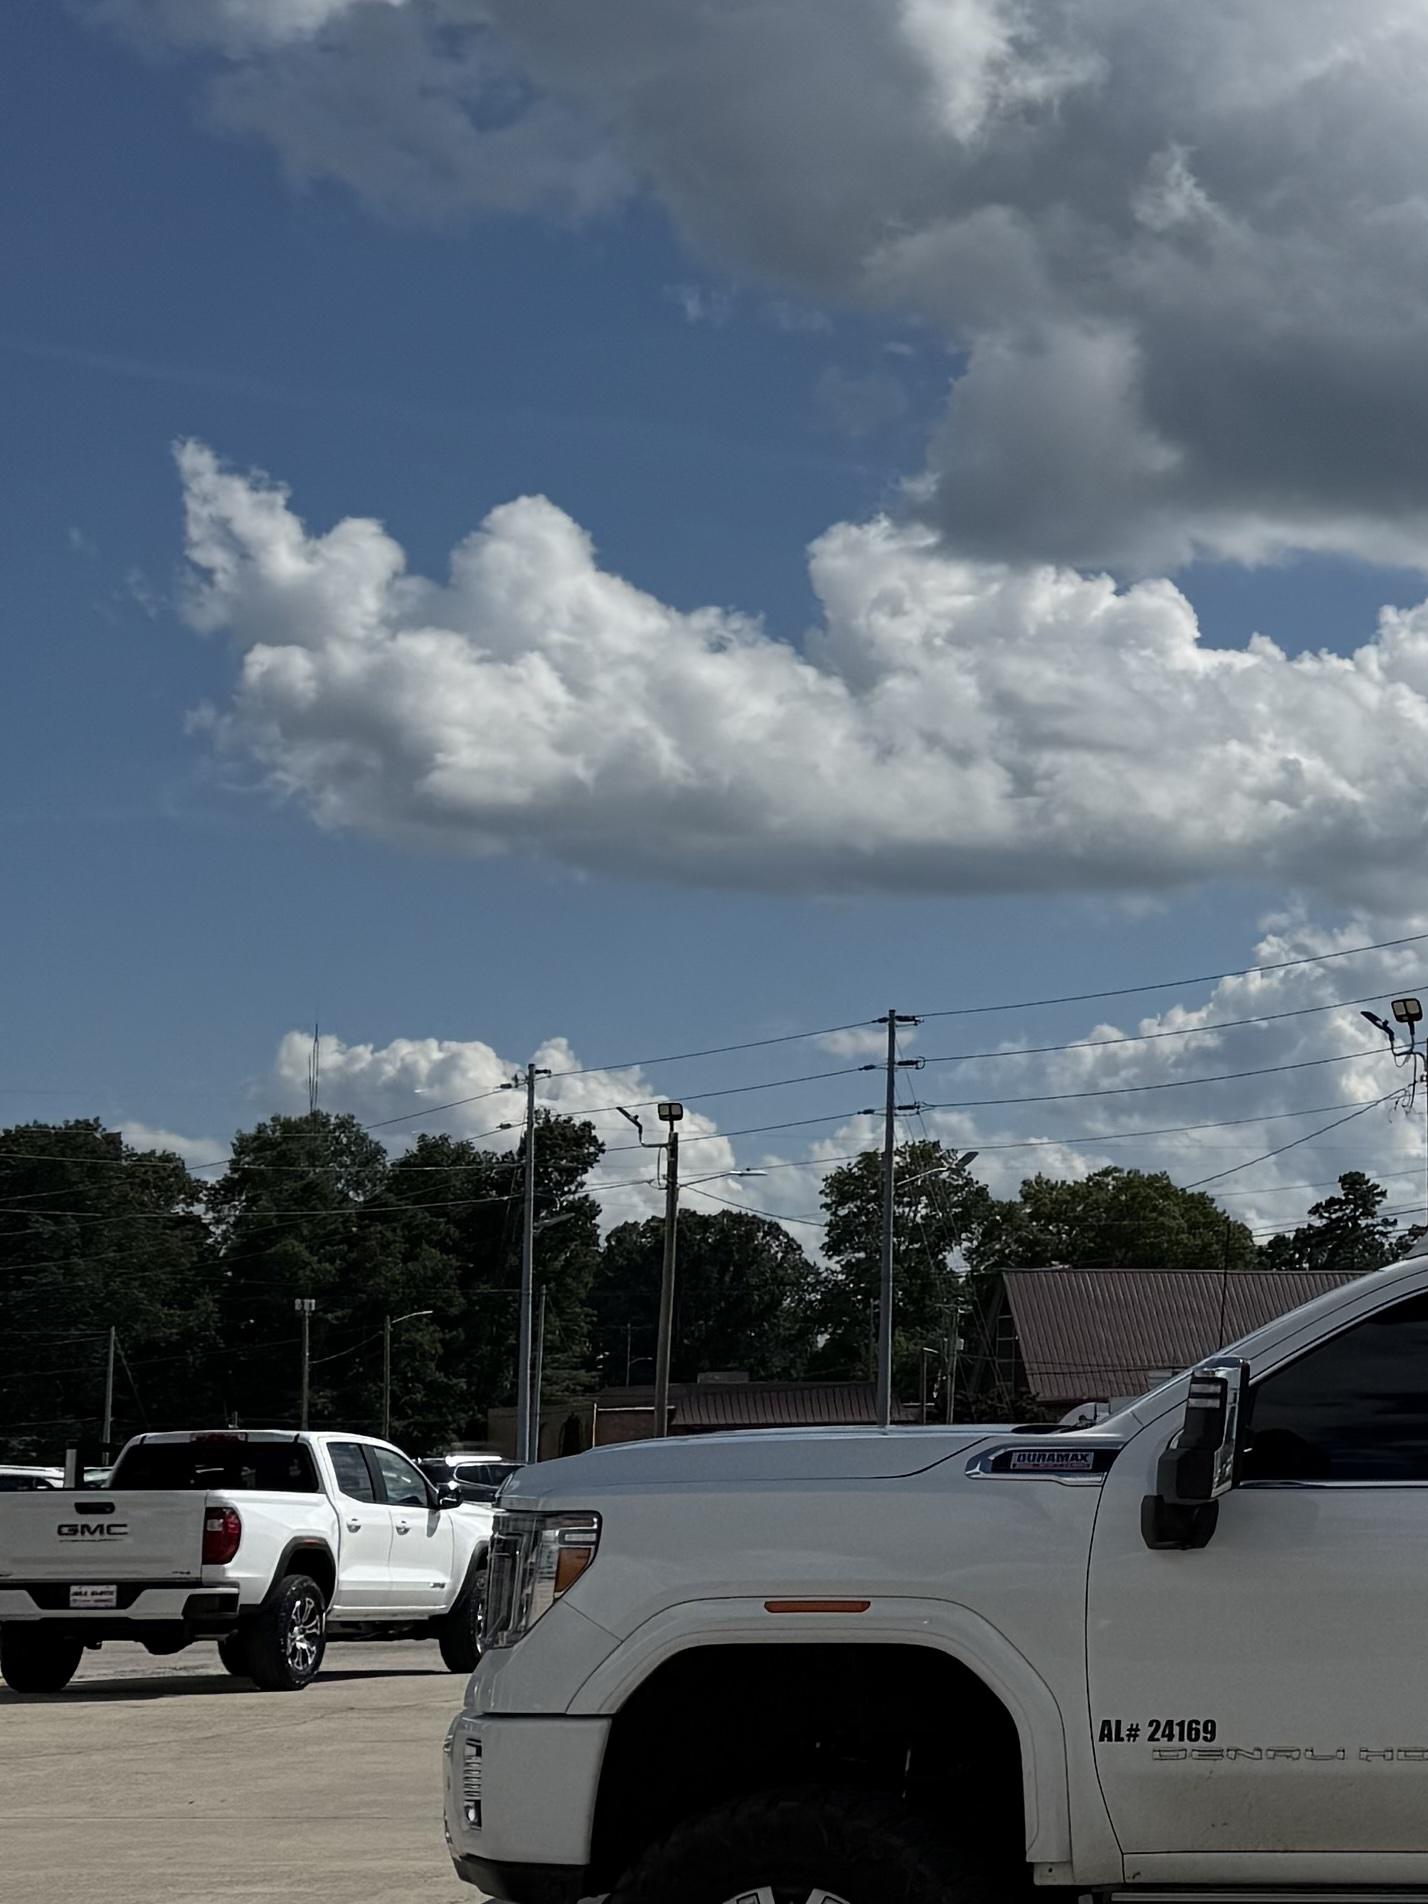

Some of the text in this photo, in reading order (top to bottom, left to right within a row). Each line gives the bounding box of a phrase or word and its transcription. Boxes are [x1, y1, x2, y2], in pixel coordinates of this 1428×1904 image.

[1016, 1452, 1089, 1463] DURAMAX
[57, 1523, 129, 1537] GMC
[1098, 1719, 1217, 1743] AL# 24169
[1151, 1748, 1346, 1761] DENALI
